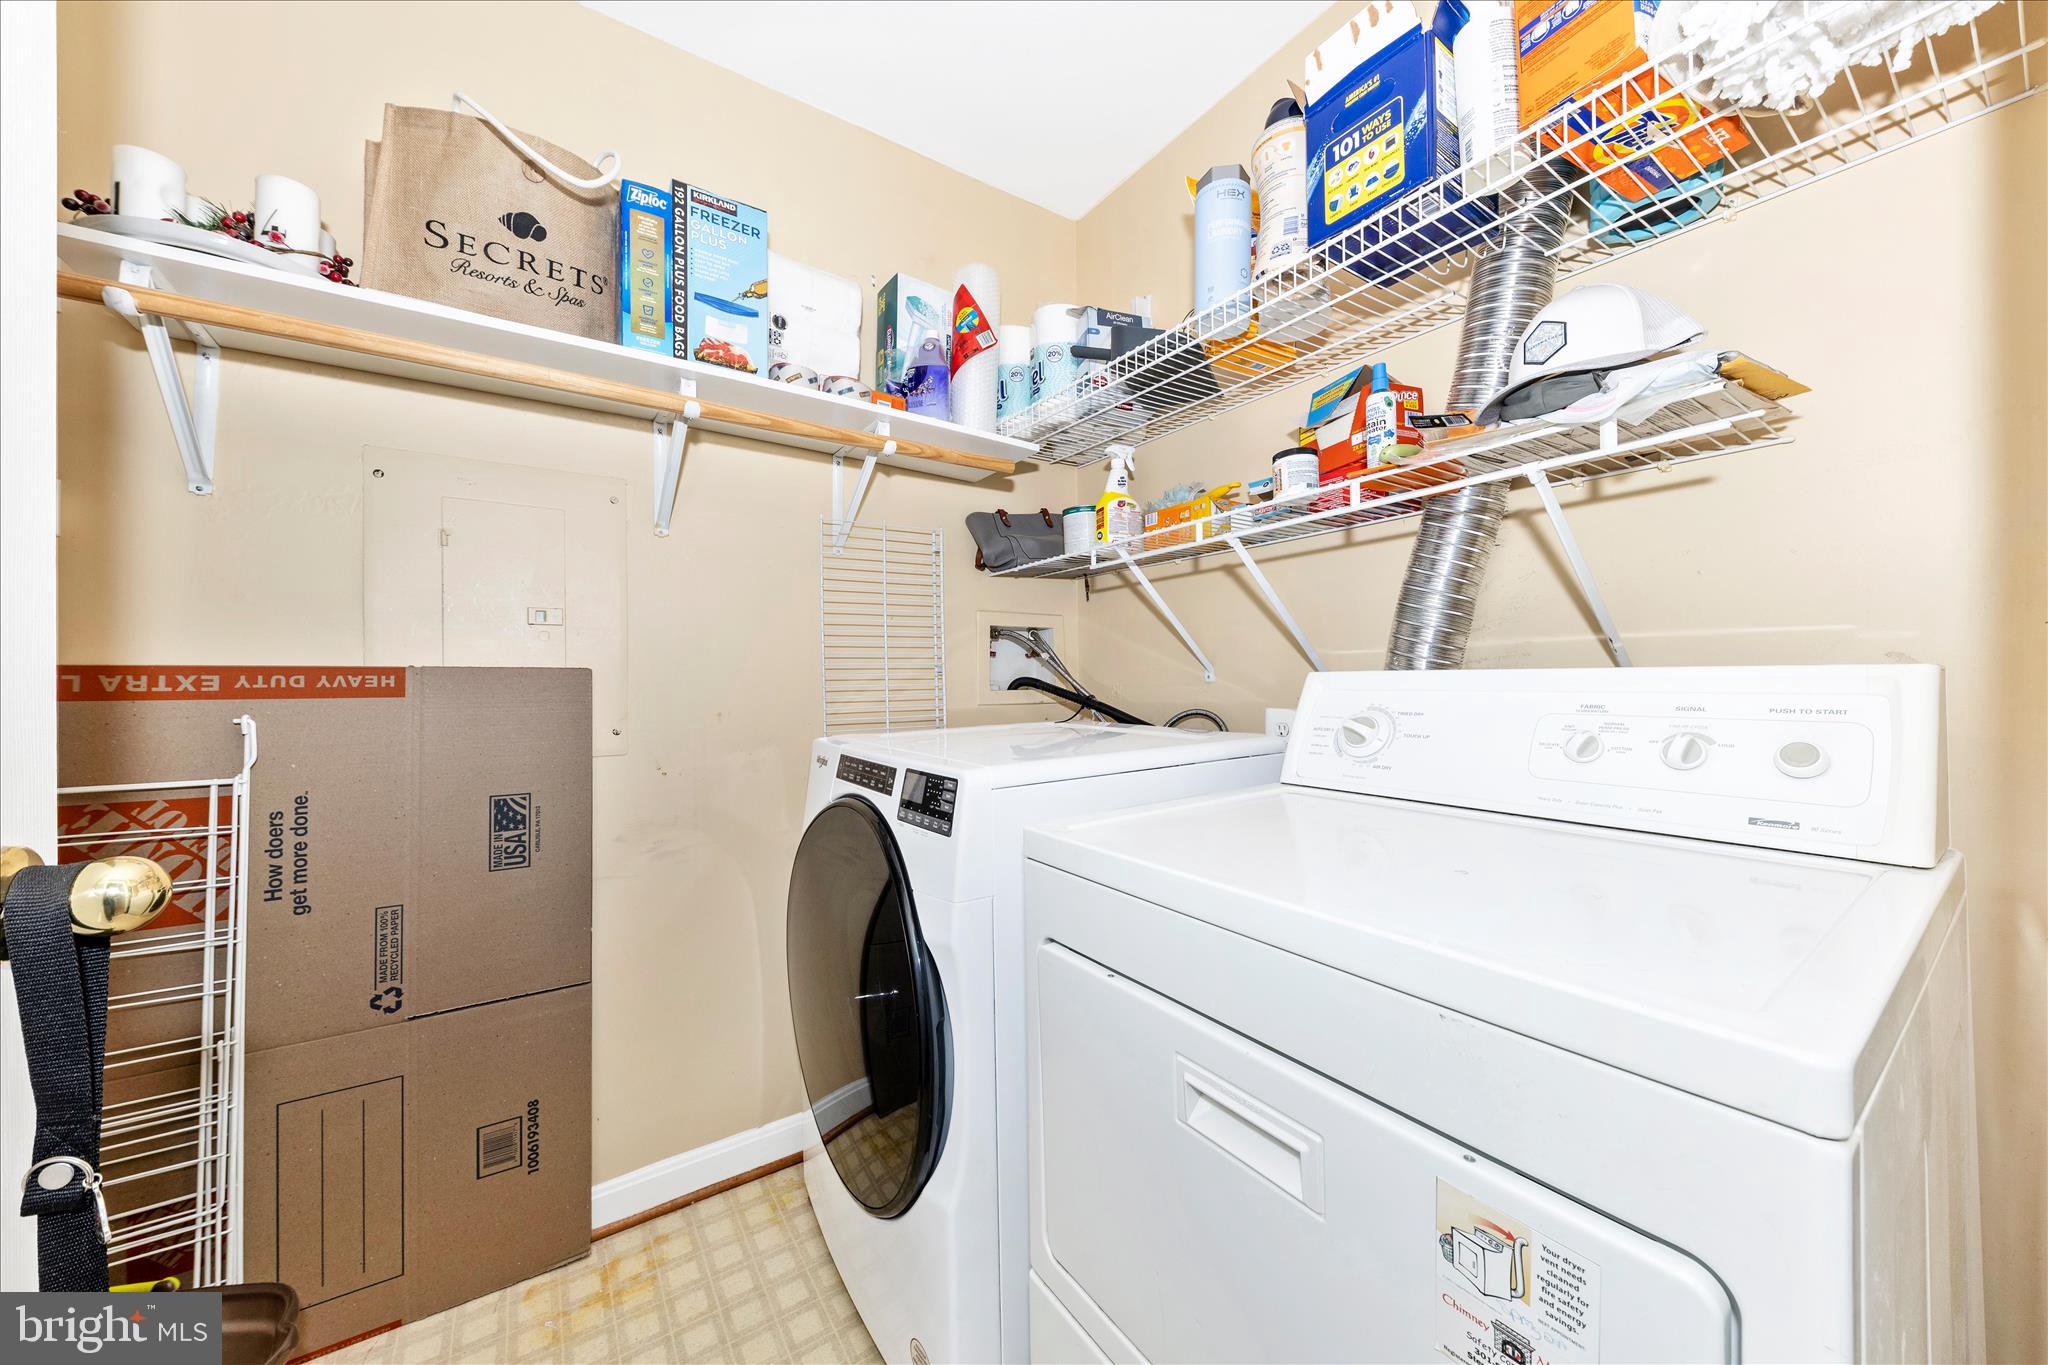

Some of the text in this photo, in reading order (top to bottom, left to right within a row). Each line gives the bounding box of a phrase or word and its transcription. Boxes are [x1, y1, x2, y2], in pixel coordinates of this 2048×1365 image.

[1332, 109, 1392, 162] 101 WAYS
[1362, 120, 1392, 143] TO USE
[630, 187, 667, 209] Ziploc
[693, 190, 736, 211] KIRKLAND
[1217, 188, 1245, 199] HEX
[690, 206, 760, 239] FREEZER
[691, 220, 748, 245] GALLON
[691, 230, 727, 250] PLUS
[450, 258, 587, 307] Resorts & Spas
[674, 186, 684, 357] 192 GALLON PLUS FOOD BAGS
[1105, 312, 1134, 323] AirClean
[1366, 418, 1387, 431] tain
[98, 675, 220, 692] EXTRA
[234, 675, 305, 688] DUTY
[315, 675, 395, 688] HEAVY
[264, 811, 284, 902] How doers
[293, 841, 308, 885] more
[493, 833, 503, 868] MADE IN
[503, 831, 527, 867] USA
[290, 888, 311, 916] get
[379, 910, 389, 984] MADE FROM 100%
[389, 909, 400, 982] RECYCLED PAPER
[527, 1099, 540, 1175] 1006193408
[1540, 1255, 1587, 1286] vent needs
[1541, 1243, 1586, 1274] Your dryer
[1536, 1274, 1590, 1309] regularly for
[1546, 1269, 1580, 1292] cleaned
[1442, 1293, 1490, 1332] Chimney
[1538, 1295, 1587, 1329] and energy
[1541, 1286, 1585, 1317] fire safety
[1544, 1310, 1580, 1335] savings.
[1465, 1331, 1497, 1358] Safety
